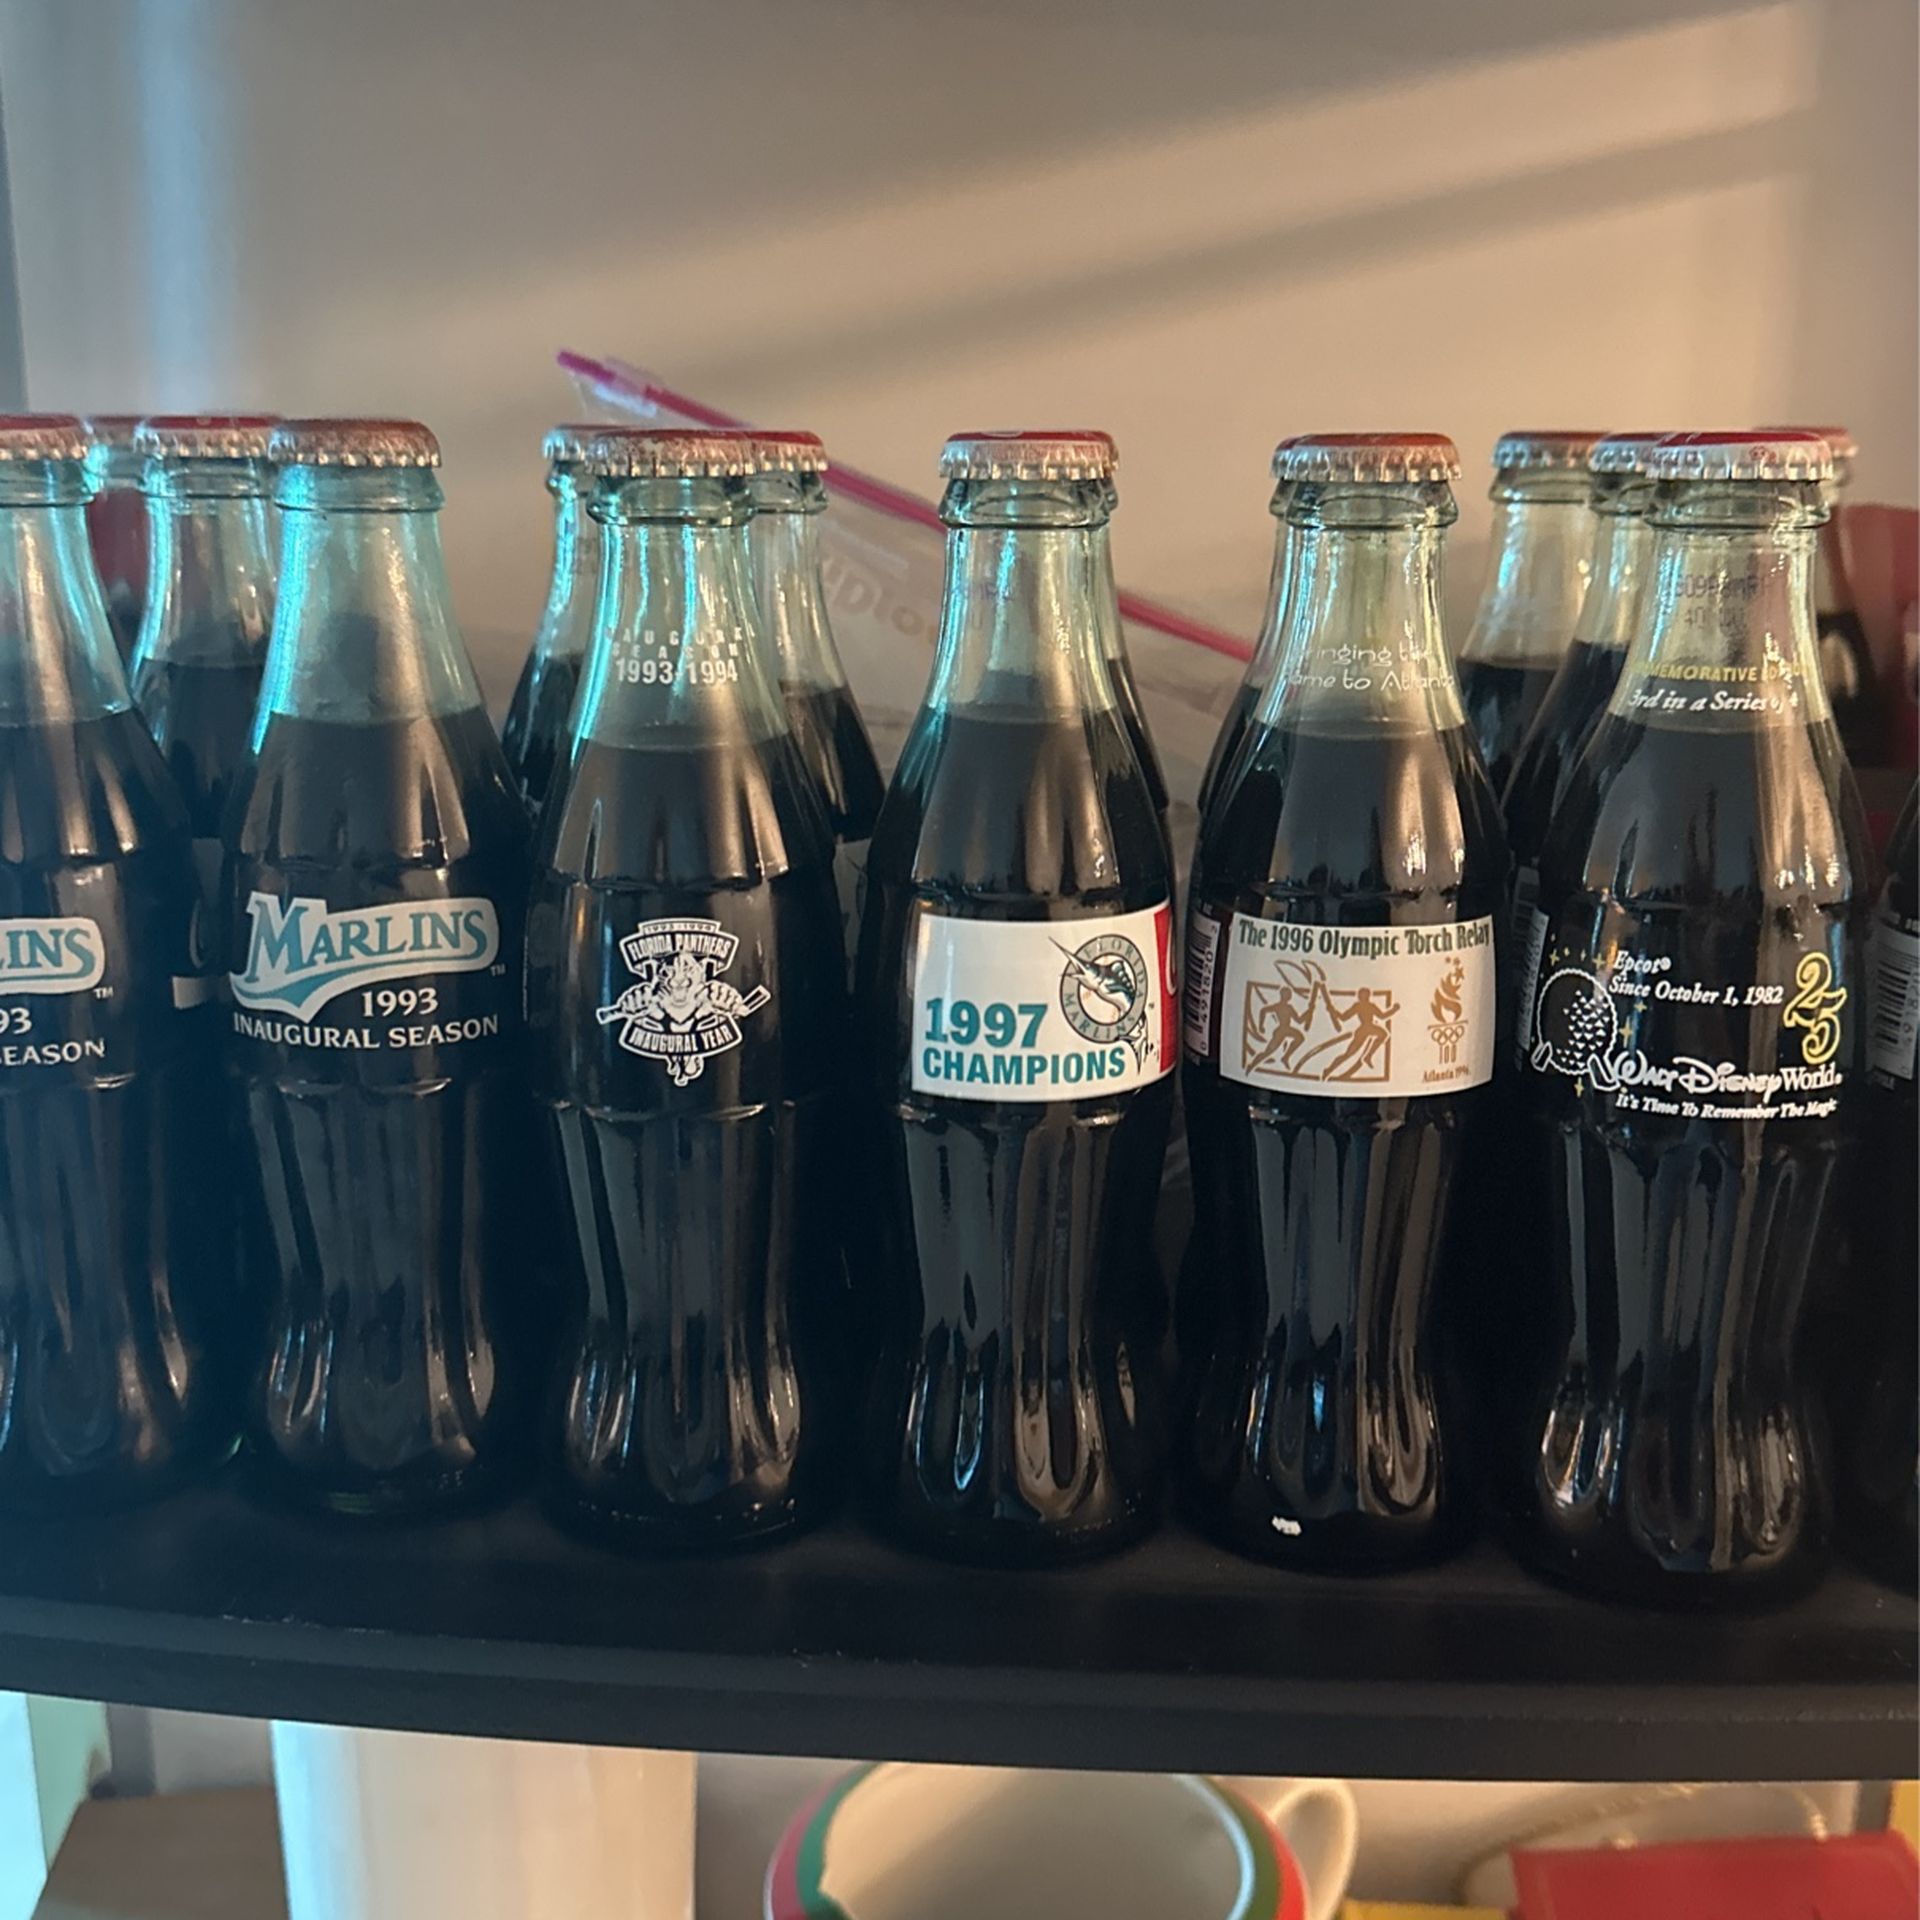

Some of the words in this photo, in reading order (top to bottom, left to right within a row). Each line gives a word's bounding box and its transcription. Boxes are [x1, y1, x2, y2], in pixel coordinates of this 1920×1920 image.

[615, 657, 738, 684] 1993-1994
[1342, 668, 1371, 690] to
[1629, 688, 1665, 708] 3rd
[1662, 690, 1687, 710] in
[1689, 697, 1707, 711] a
[1709, 690, 1766, 712] Series
[244, 899, 488, 984] MARLINS
[627, 933, 673, 962] FLORIDA
[675, 933, 732, 959] PANTHERS
[1239, 919, 1266, 948] The
[1271, 925, 1314, 952] 1996
[1319, 928, 1400, 960] Olympic
[1404, 928, 1453, 954] Torch
[1456, 921, 1489, 950] Relay
[362, 986, 439, 1018] 1993
[1609, 974, 1651, 998] Since
[1655, 980, 1719, 1004] October
[1723, 986, 1739, 1006] 1,
[1744, 985, 1784, 1005] 1982
[233, 1012, 380, 1048] INAUGURAL
[388, 1014, 499, 1049] SEASON
[628, 1027, 699, 1052] INAUGURAL
[700, 1024, 734, 1050] YEAR
[925, 997, 1048, 1049] 1997
[0, 1037, 105, 1066] EASON
[923, 1047, 1126, 1085] CHAMPIONS
[1616, 1092, 1639, 1108] It's
[1642, 1097, 1679, 1116] Time
[1682, 1101, 1699, 1117] To
[1701, 1102, 1780, 1120] Remember
[1780, 1101, 1805, 1119] The
